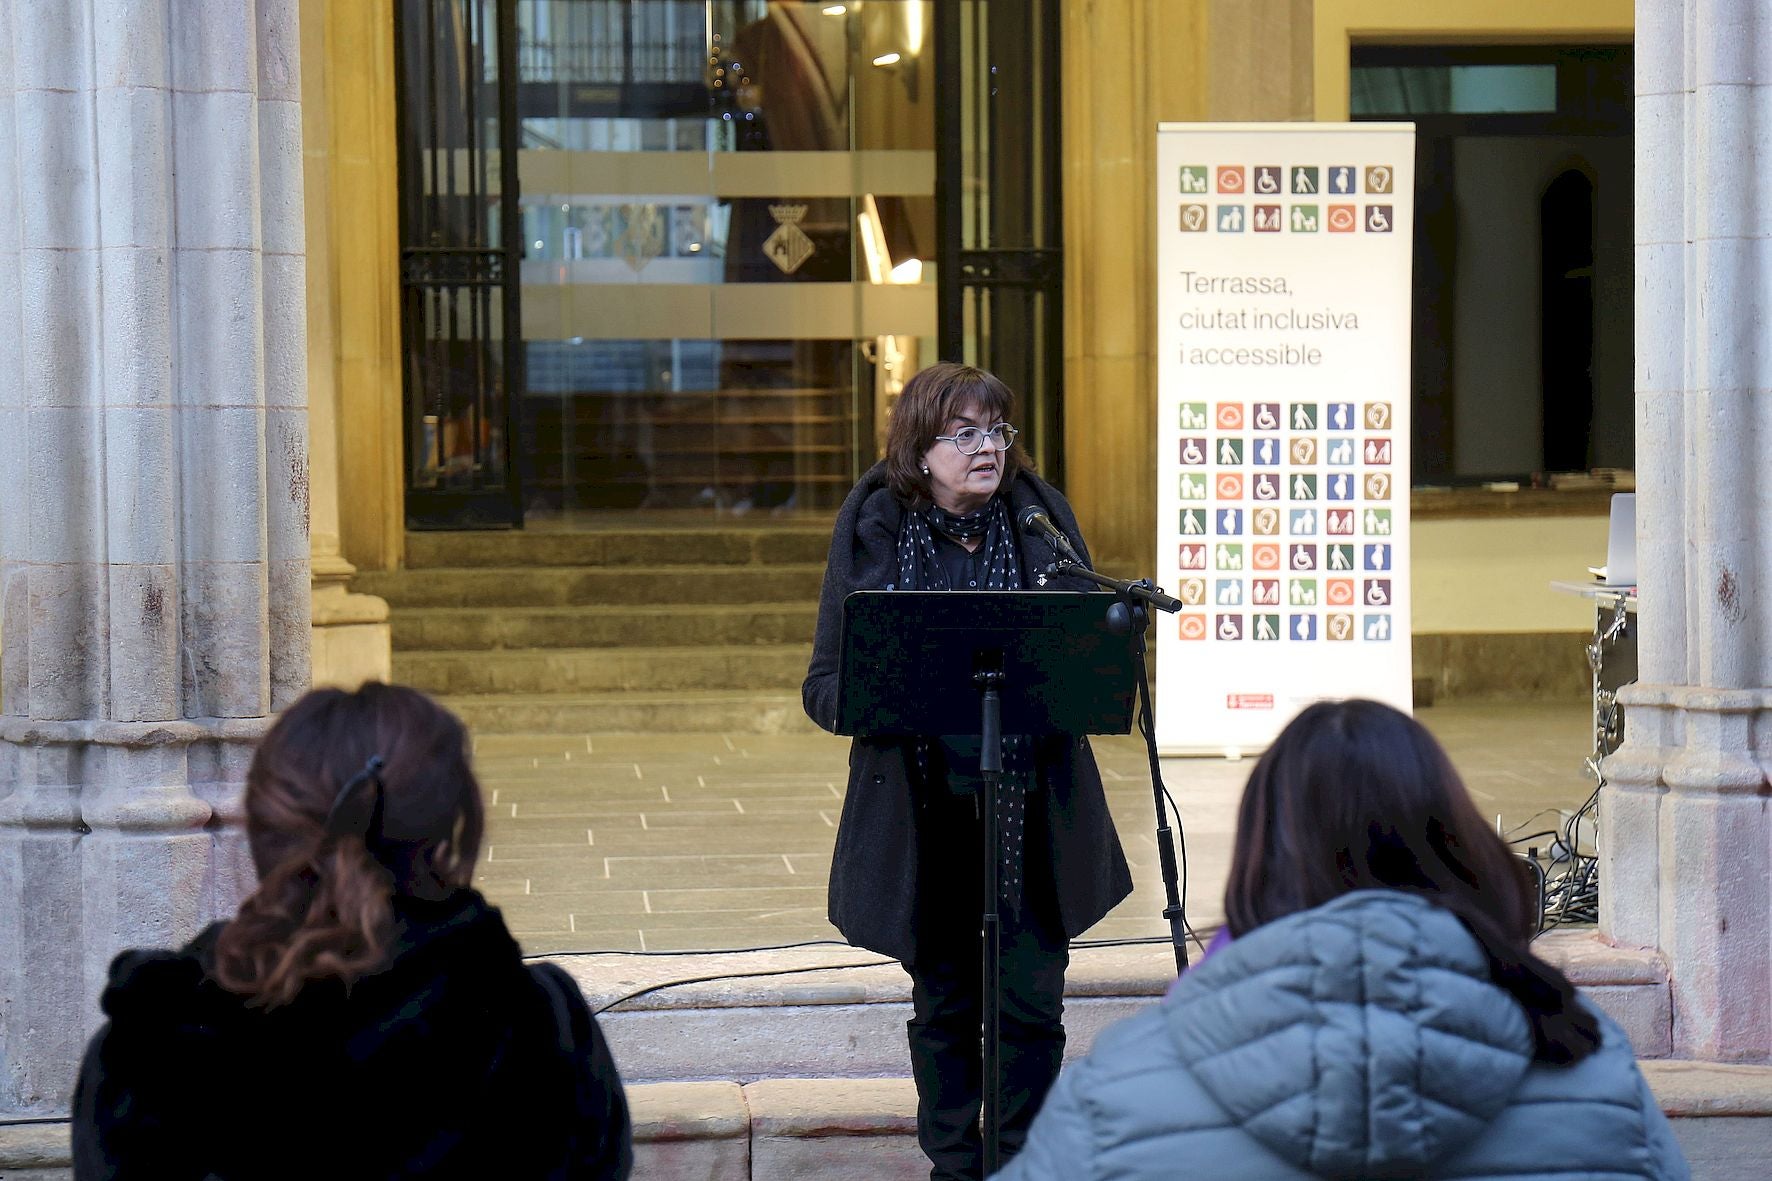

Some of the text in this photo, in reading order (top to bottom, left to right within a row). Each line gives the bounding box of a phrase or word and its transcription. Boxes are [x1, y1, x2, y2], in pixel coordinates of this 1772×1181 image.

[1180, 271, 1293, 296] Terrassa,
[1179, 307, 1359, 330] ciutat inclusiva
[1190, 343, 1322, 365] accessible
